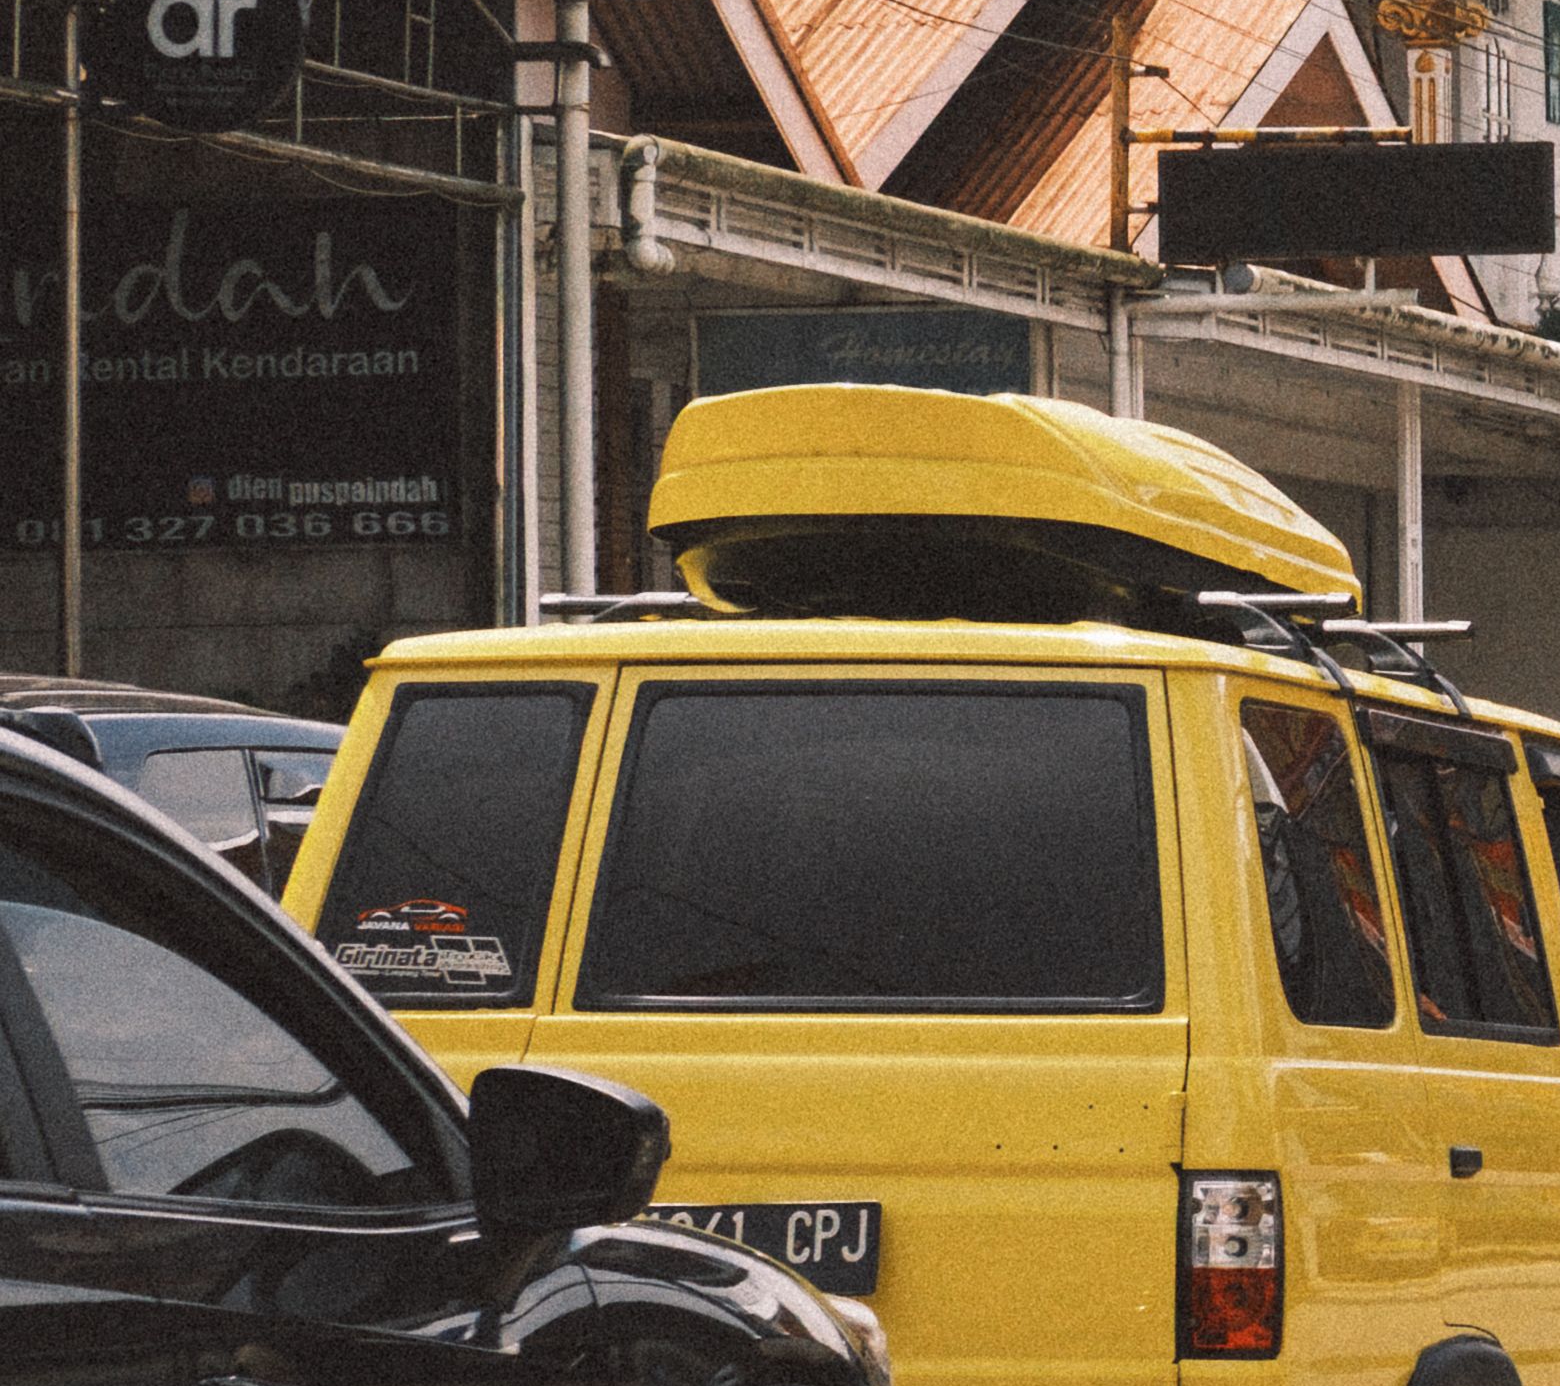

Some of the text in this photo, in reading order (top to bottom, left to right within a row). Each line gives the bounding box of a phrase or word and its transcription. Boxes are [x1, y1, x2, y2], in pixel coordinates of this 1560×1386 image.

[201, 346, 421, 382] Kendaraan
[125, 515, 214, 542] 327
[236, 512, 332, 539] 036
[337, 944, 438, 967] Girinata
[785, 1209, 868, 1264] CPJ
